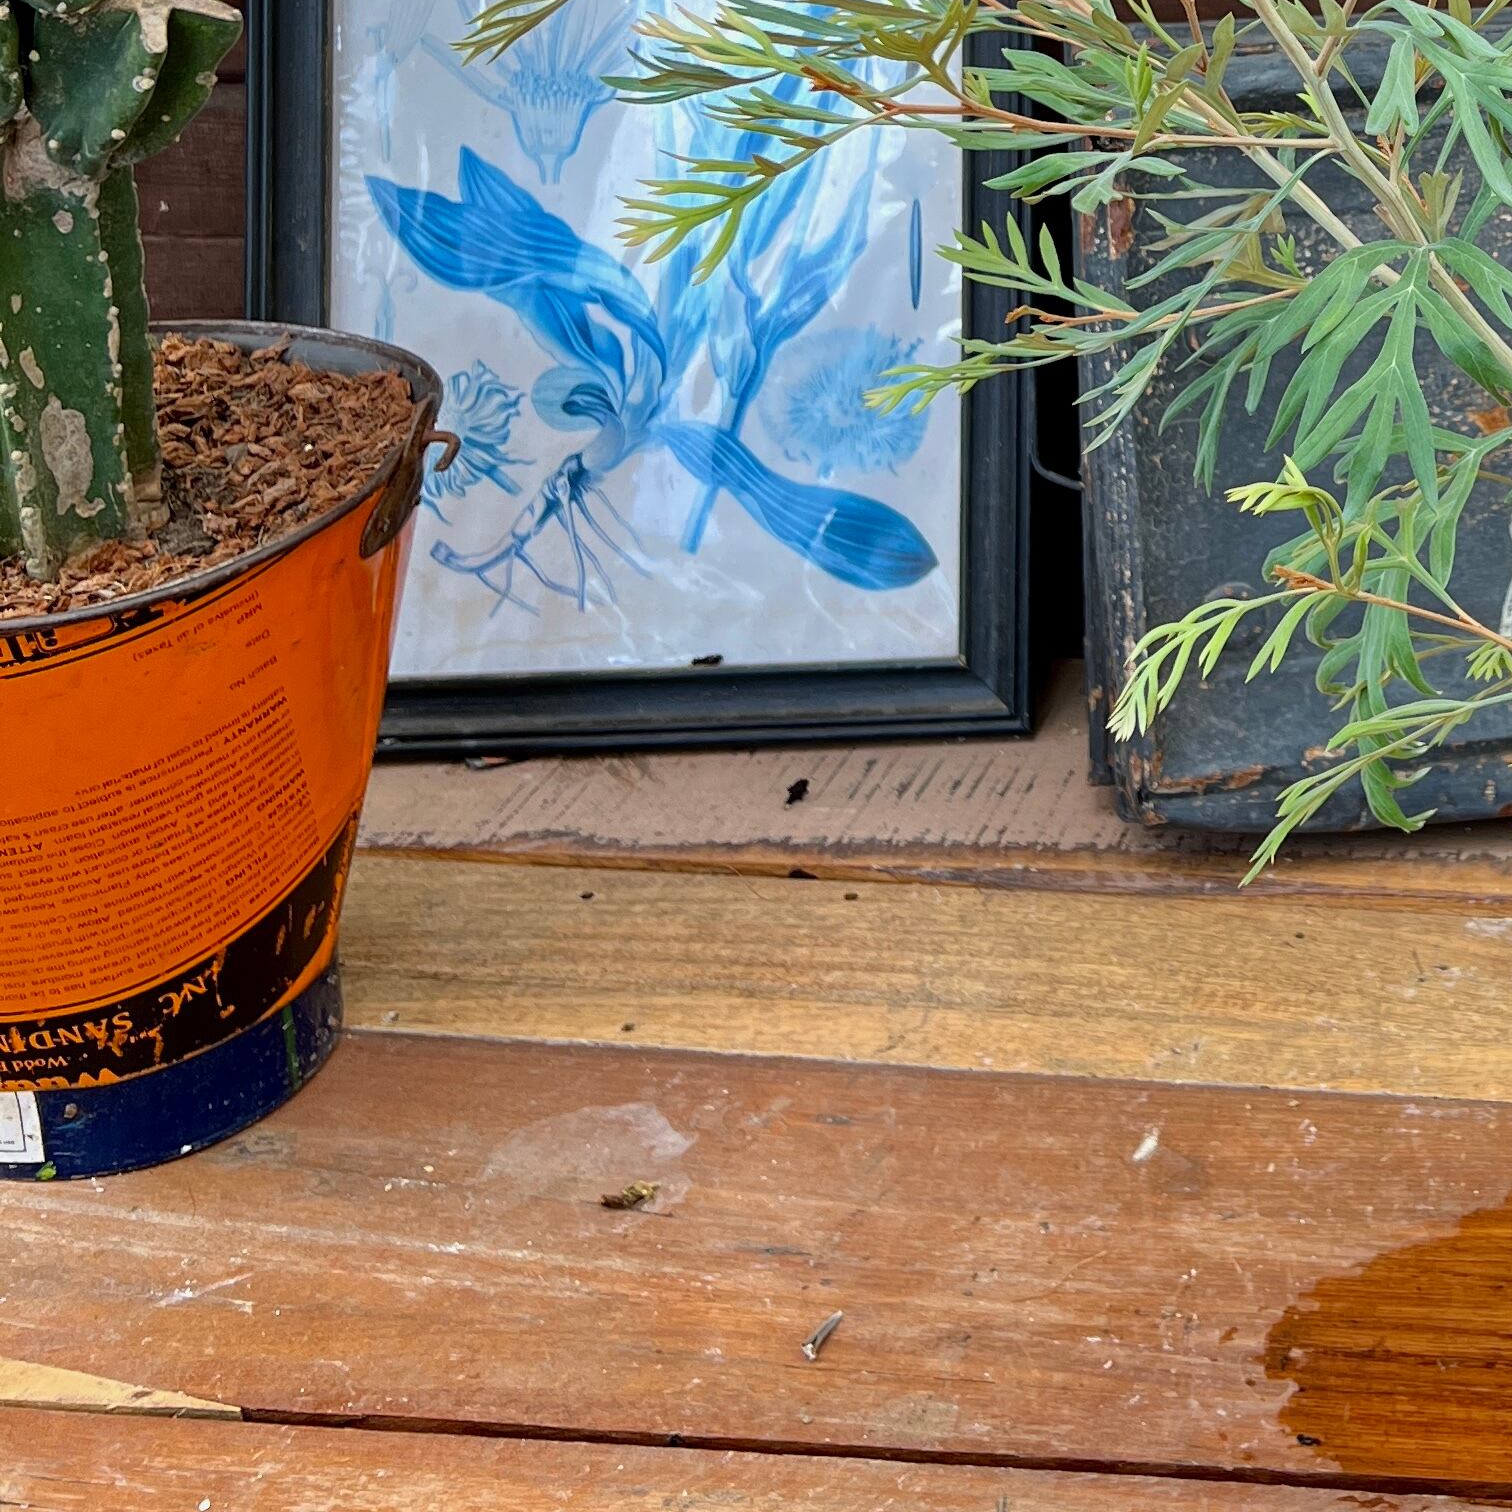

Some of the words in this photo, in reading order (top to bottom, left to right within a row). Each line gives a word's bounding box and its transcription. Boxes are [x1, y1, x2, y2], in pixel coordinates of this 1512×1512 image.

[235, 601, 265, 627] MRP
[243, 628, 273, 651] Date
[11, 1055, 69, 1075] Wood
